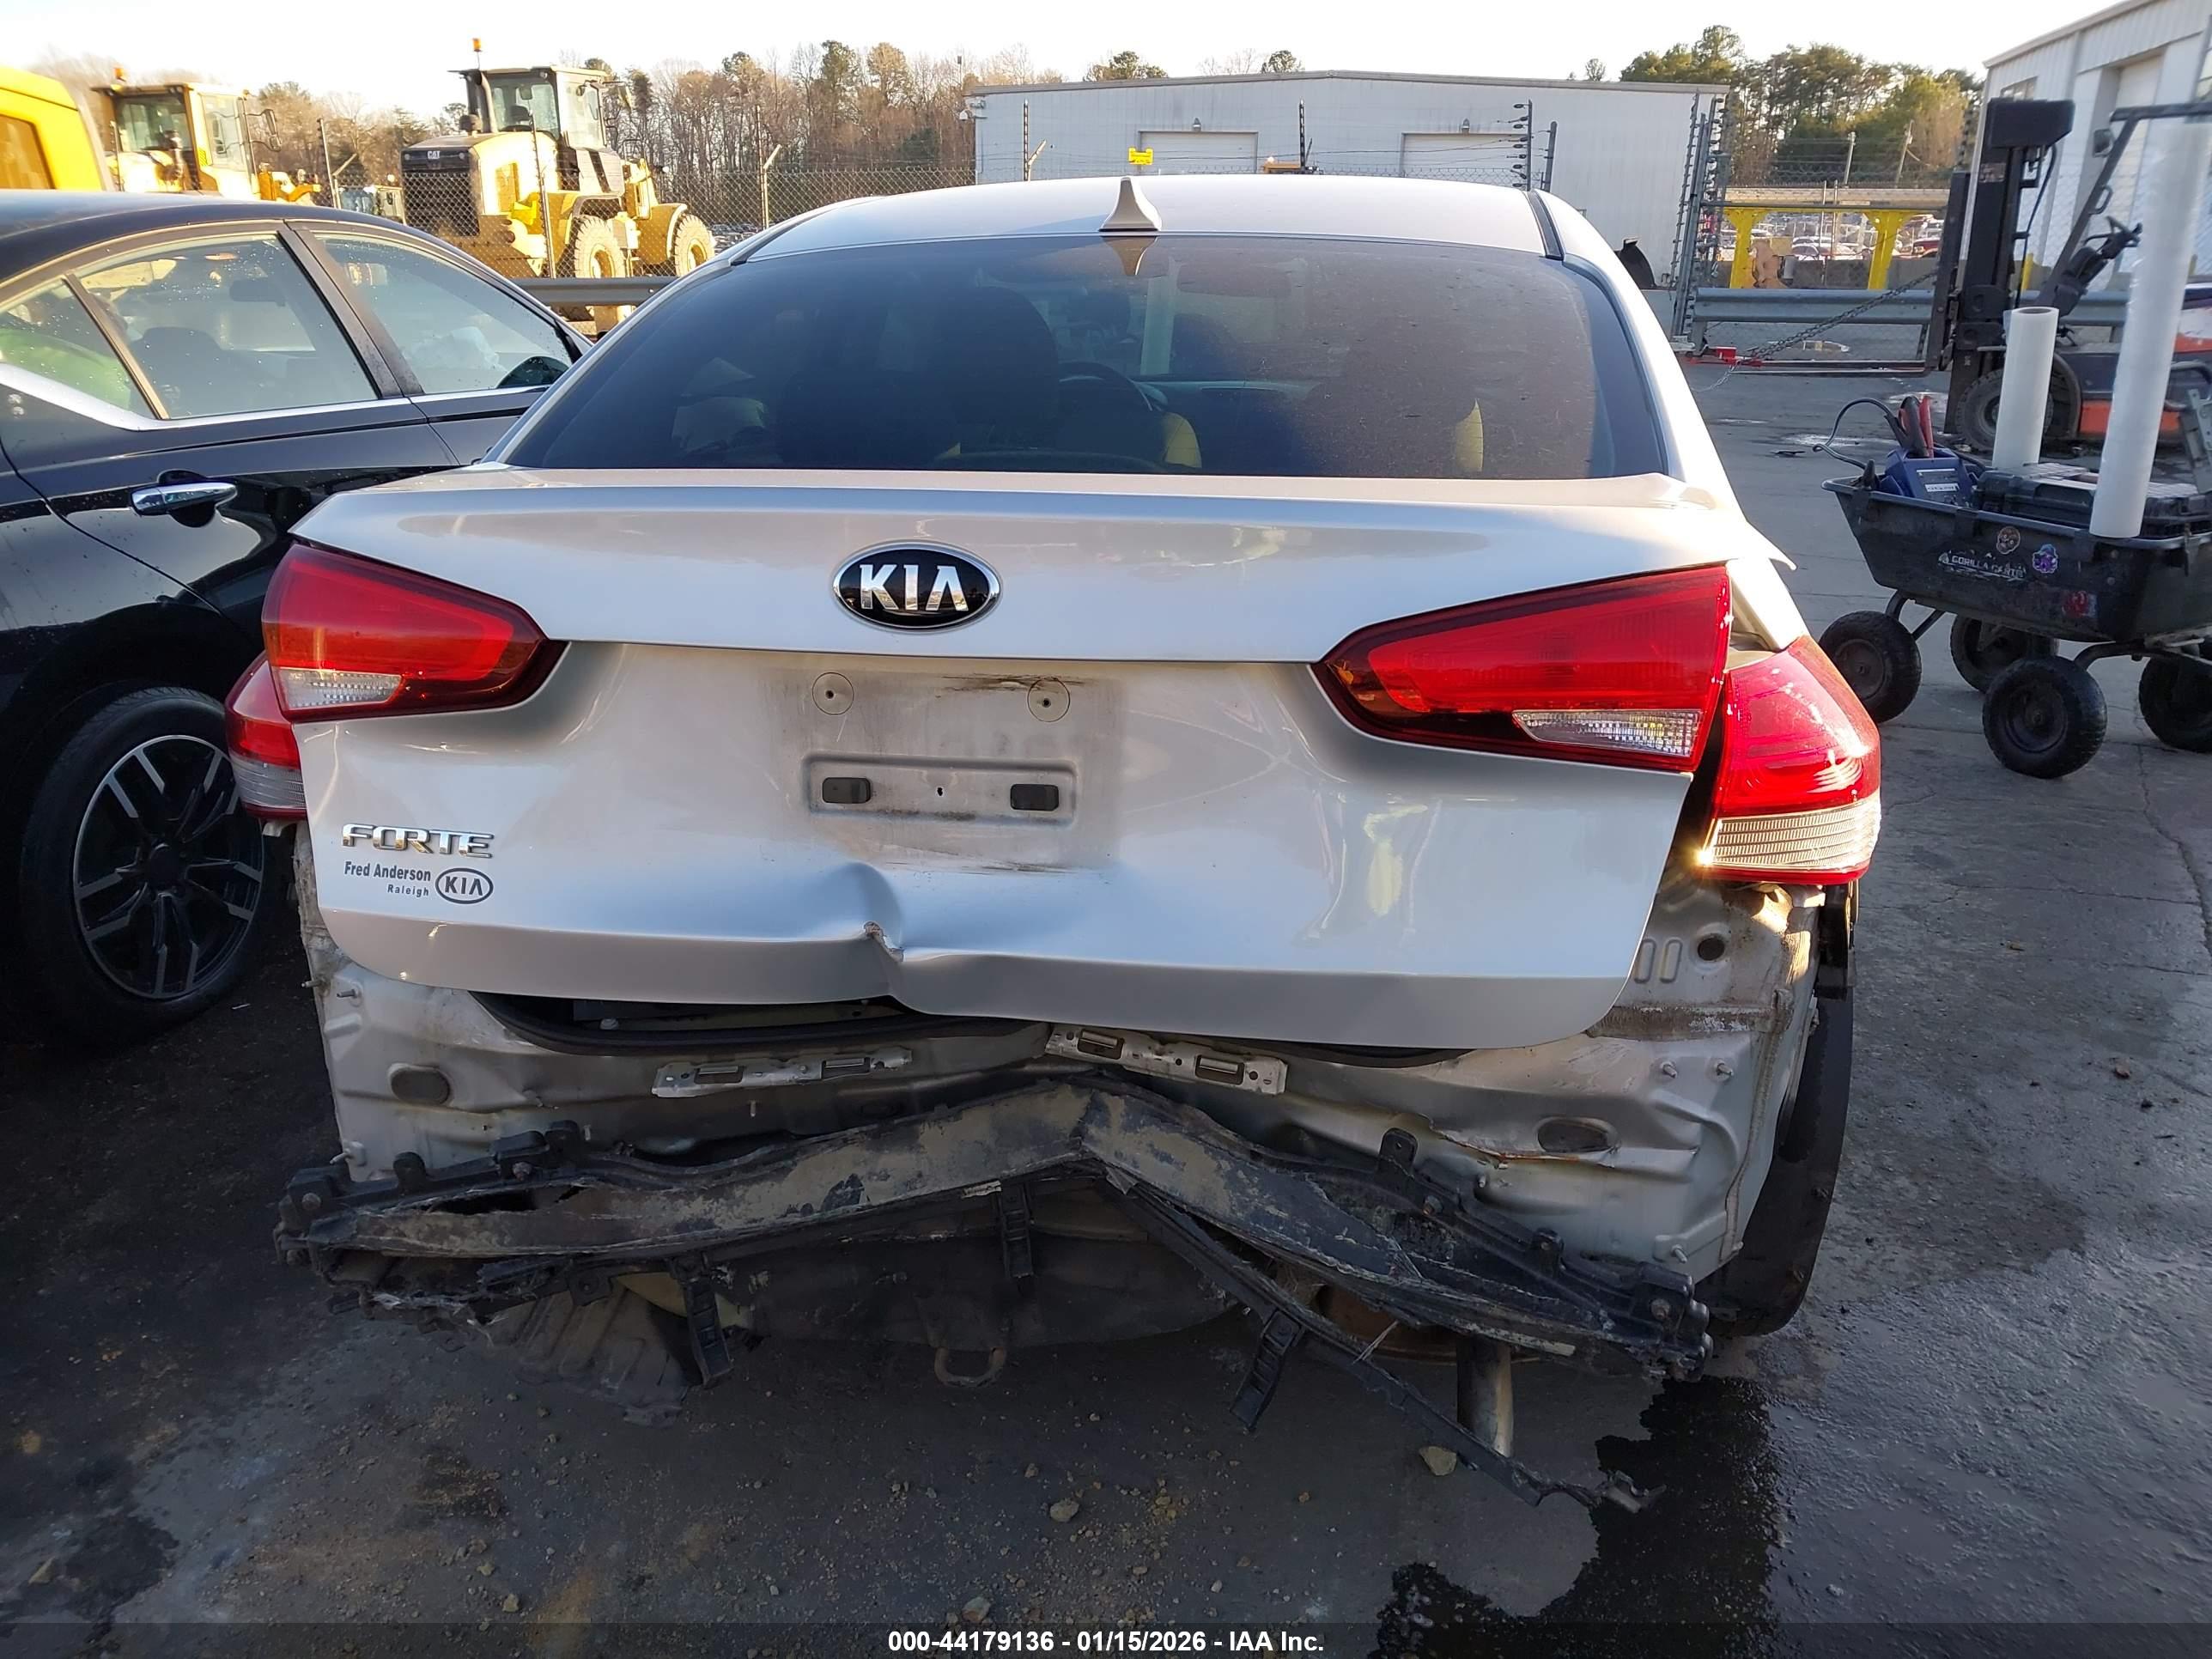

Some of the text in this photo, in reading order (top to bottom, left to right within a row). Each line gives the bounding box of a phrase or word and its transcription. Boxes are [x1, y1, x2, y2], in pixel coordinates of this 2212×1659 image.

[1951, 555, 1989, 570] GORILLA
[860, 563, 969, 611] KIA
[342, 823, 495, 860] FORTE
[344, 860, 431, 882] Fred Anderson
[387, 884, 429, 898] Raleigh
[444, 875, 483, 896] KIA
